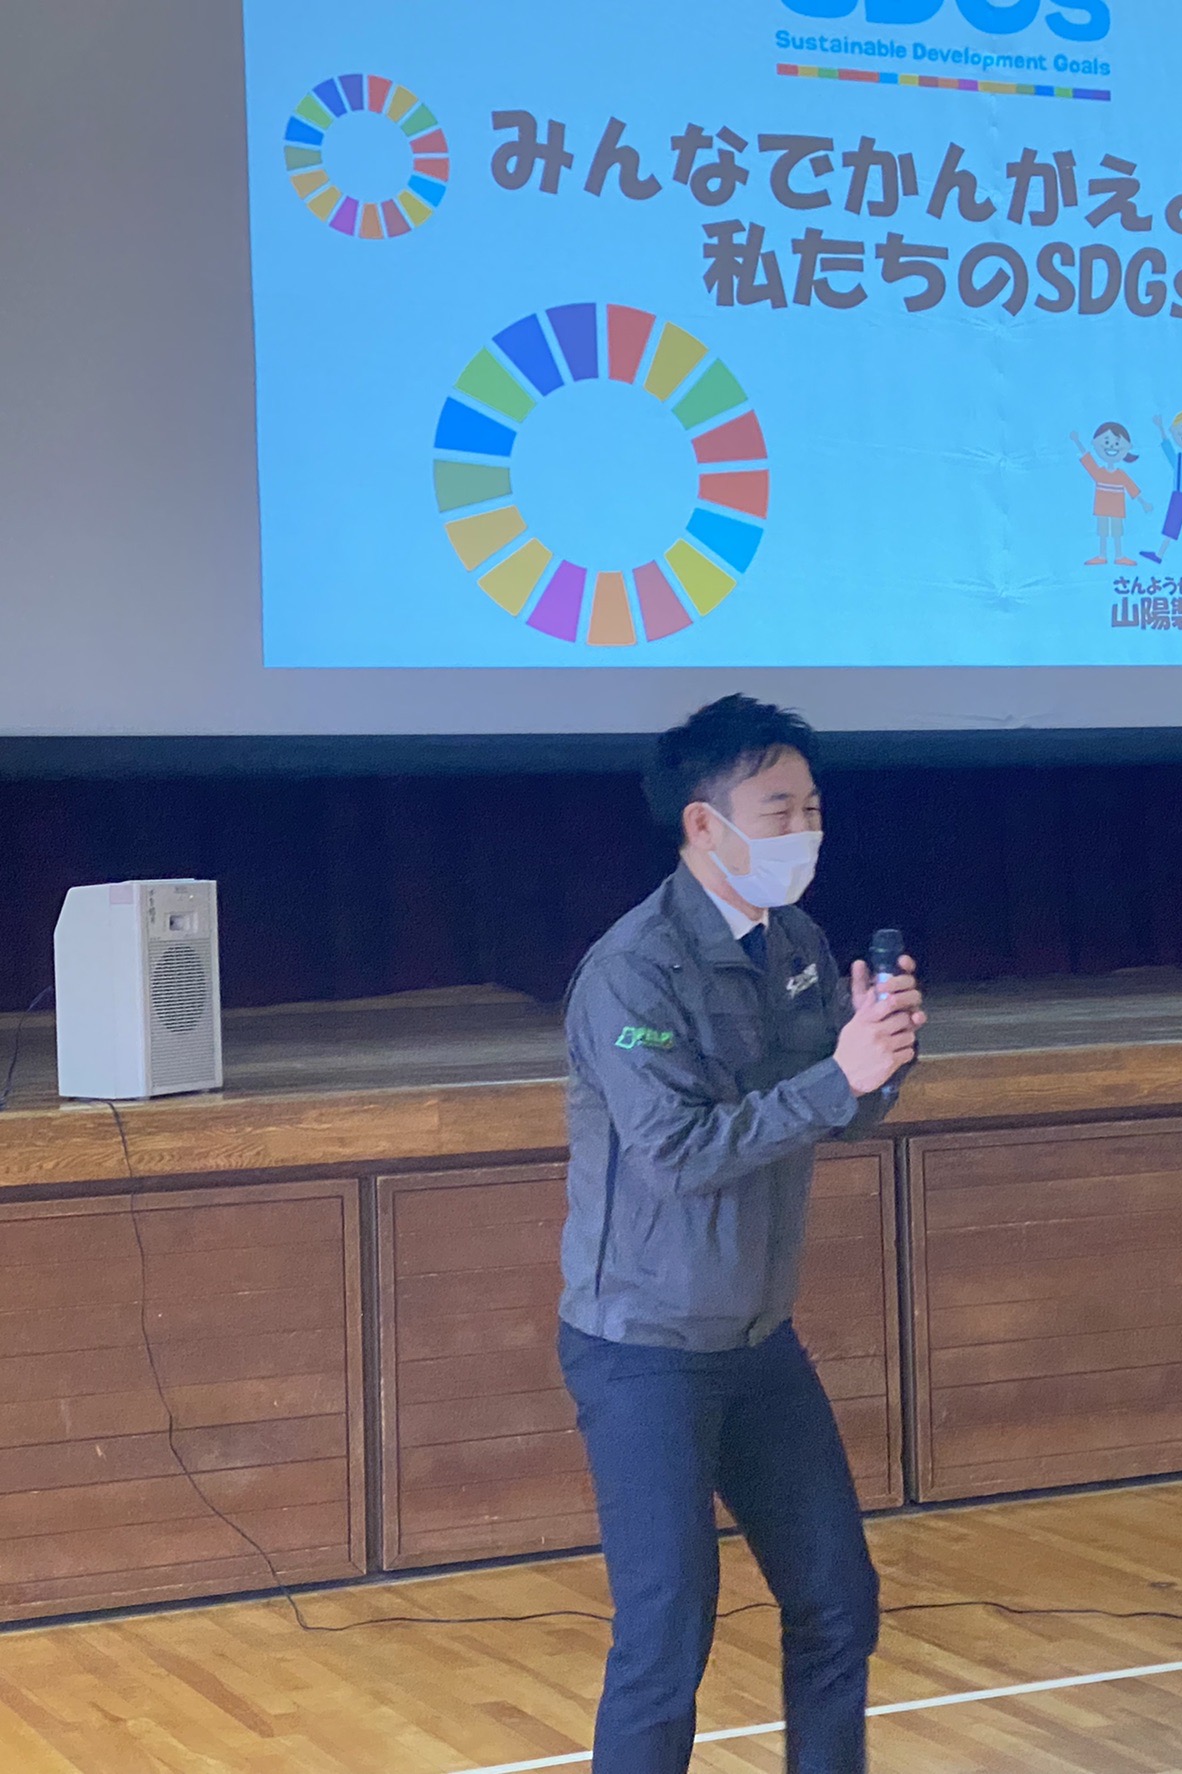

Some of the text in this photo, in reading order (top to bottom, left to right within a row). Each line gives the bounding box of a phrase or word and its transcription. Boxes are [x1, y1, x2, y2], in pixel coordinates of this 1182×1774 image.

[776, 30, 1112, 76] Sustainable Development Goals
